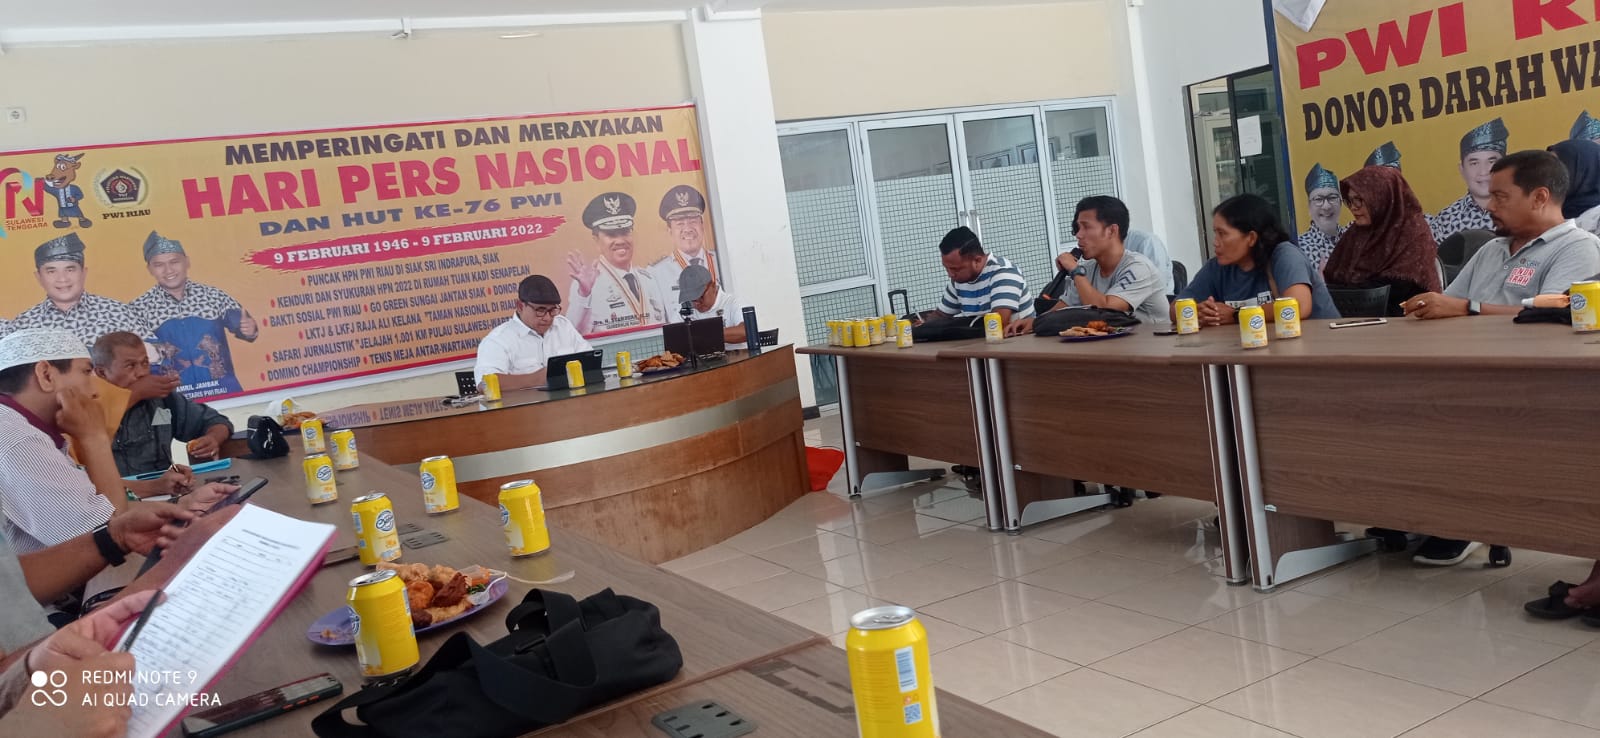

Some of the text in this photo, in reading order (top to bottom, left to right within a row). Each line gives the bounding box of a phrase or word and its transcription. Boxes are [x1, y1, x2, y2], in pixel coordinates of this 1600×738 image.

[1296, 0, 1600, 90] PWI R
[1302, 83, 1414, 141] DONOR
[1419, 52, 1546, 119] DARAH
[225, 115, 663, 165] MEMPERINGATI DAN MERAYAKAN
[182, 138, 701, 219] HARI PERS NASIONAL
[6, 217, 44, 226] SULAWESI
[7, 223, 48, 231] TENGGARA
[102, 209, 151, 219] PWI RIAU
[259, 192, 563, 236] DAN HUT KE-76 PWI
[273, 252, 284, 264] 9
[287, 243, 370, 262] FEBRUARI
[374, 238, 409, 253] 1946
[422, 236, 431, 248] 9
[433, 226, 507, 245] FEBRUARI
[510, 223, 543, 236] 2022
[277, 264, 530, 308] KENDURI DAN SYUKURAN HPN 2022 DI RUMAH TUAN KADI SENAPELAN
[307, 273, 340, 286] PUNCAK
[342, 271, 358, 282] HPN
[360, 269, 374, 279] PWI
[376, 265, 393, 276] RIAU
[396, 265, 403, 275] DI
[405, 262, 423, 274] SIAK
[425, 261, 436, 271] SRI
[482, 252, 500, 264] SIAK
[270, 283, 518, 327] BAKTI SOSIAL PWI RIAU GO GREEN SUNGAI JANTAN SIAK DONOR
[305, 327, 326, 340] LKTJ
[327, 326, 334, 337] &
[336, 323, 355, 336] LKFJ
[357, 320, 376, 333] RAJA
[378, 318, 390, 330] ALI
[392, 313, 422, 327] KELANA
[455, 303, 490, 317] NASIONAL
[491, 302, 499, 313] DI
[273, 349, 302, 362] SAFARI
[304, 341, 355, 358] JURNALISTIK
[395, 331, 413, 344] 1.001
[415, 329, 428, 340] KM
[429, 326, 452, 339] PULAU
[267, 366, 300, 381] DOMINO
[302, 356, 361, 376] CHAMPIONSHIP
[369, 350, 392, 364] TENIS
[394, 346, 414, 360] MEJA
[176, 380, 219, 393] AMRIL JAMBAK
[184, 391, 203, 399] ETARIS
